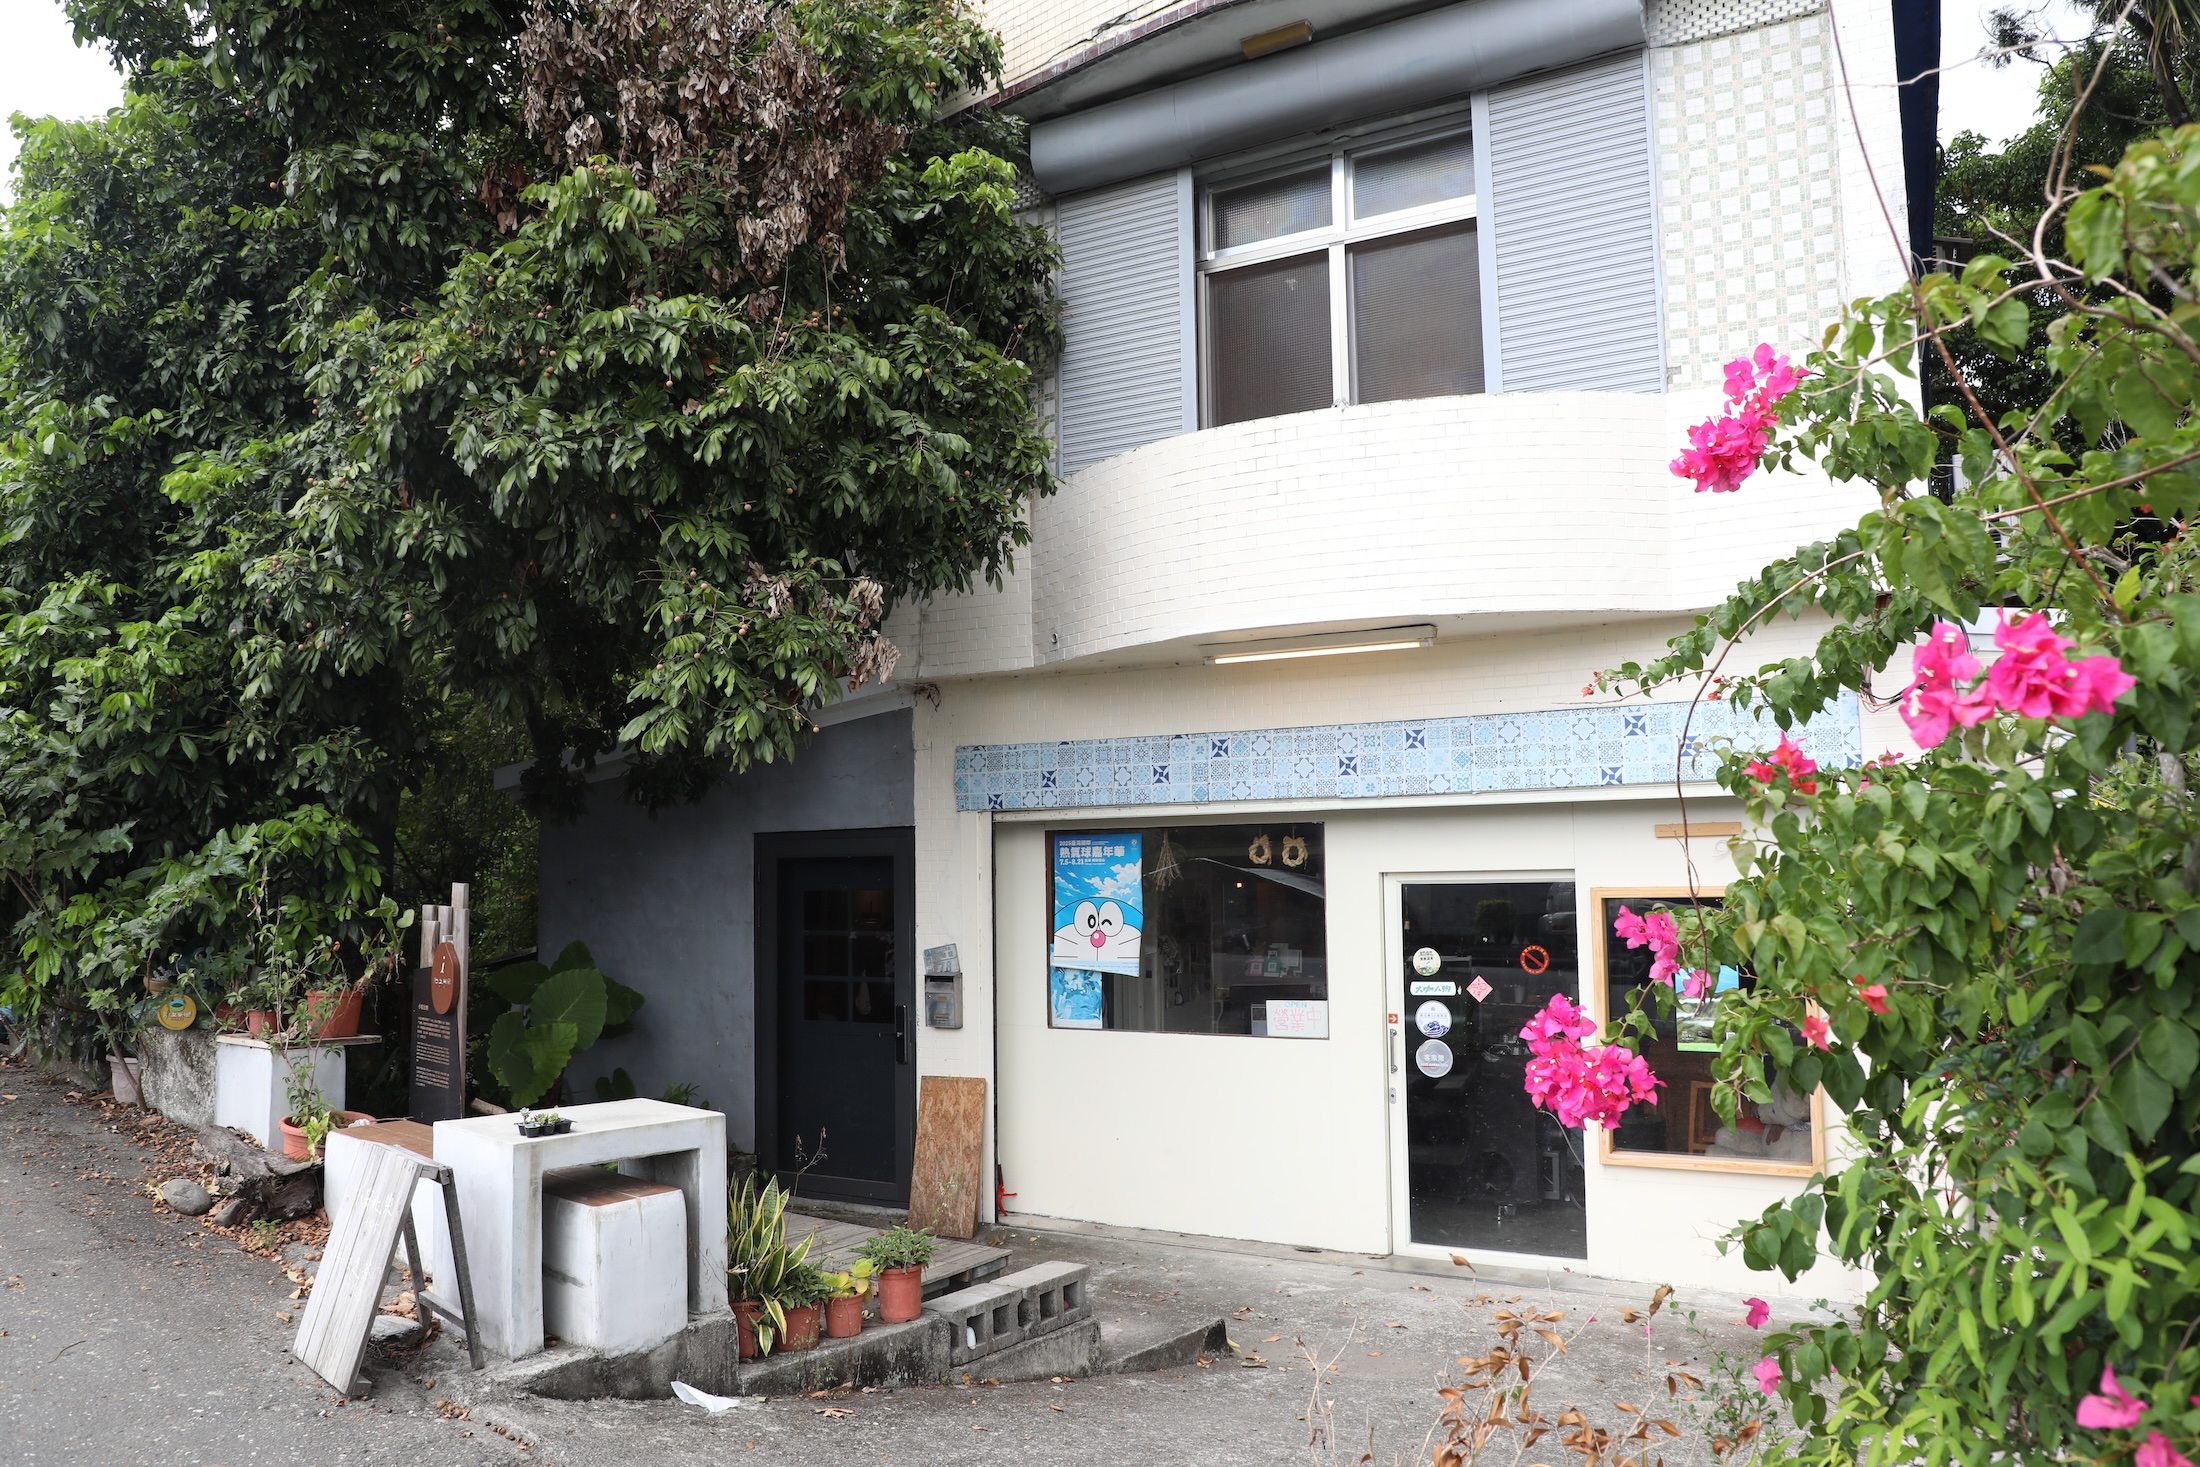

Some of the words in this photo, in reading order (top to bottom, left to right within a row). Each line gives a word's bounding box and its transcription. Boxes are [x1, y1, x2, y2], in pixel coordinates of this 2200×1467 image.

[1059, 845, 1125, 858] 熱氣球嘉年華
[1273, 1006, 1322, 1032] 營業中
